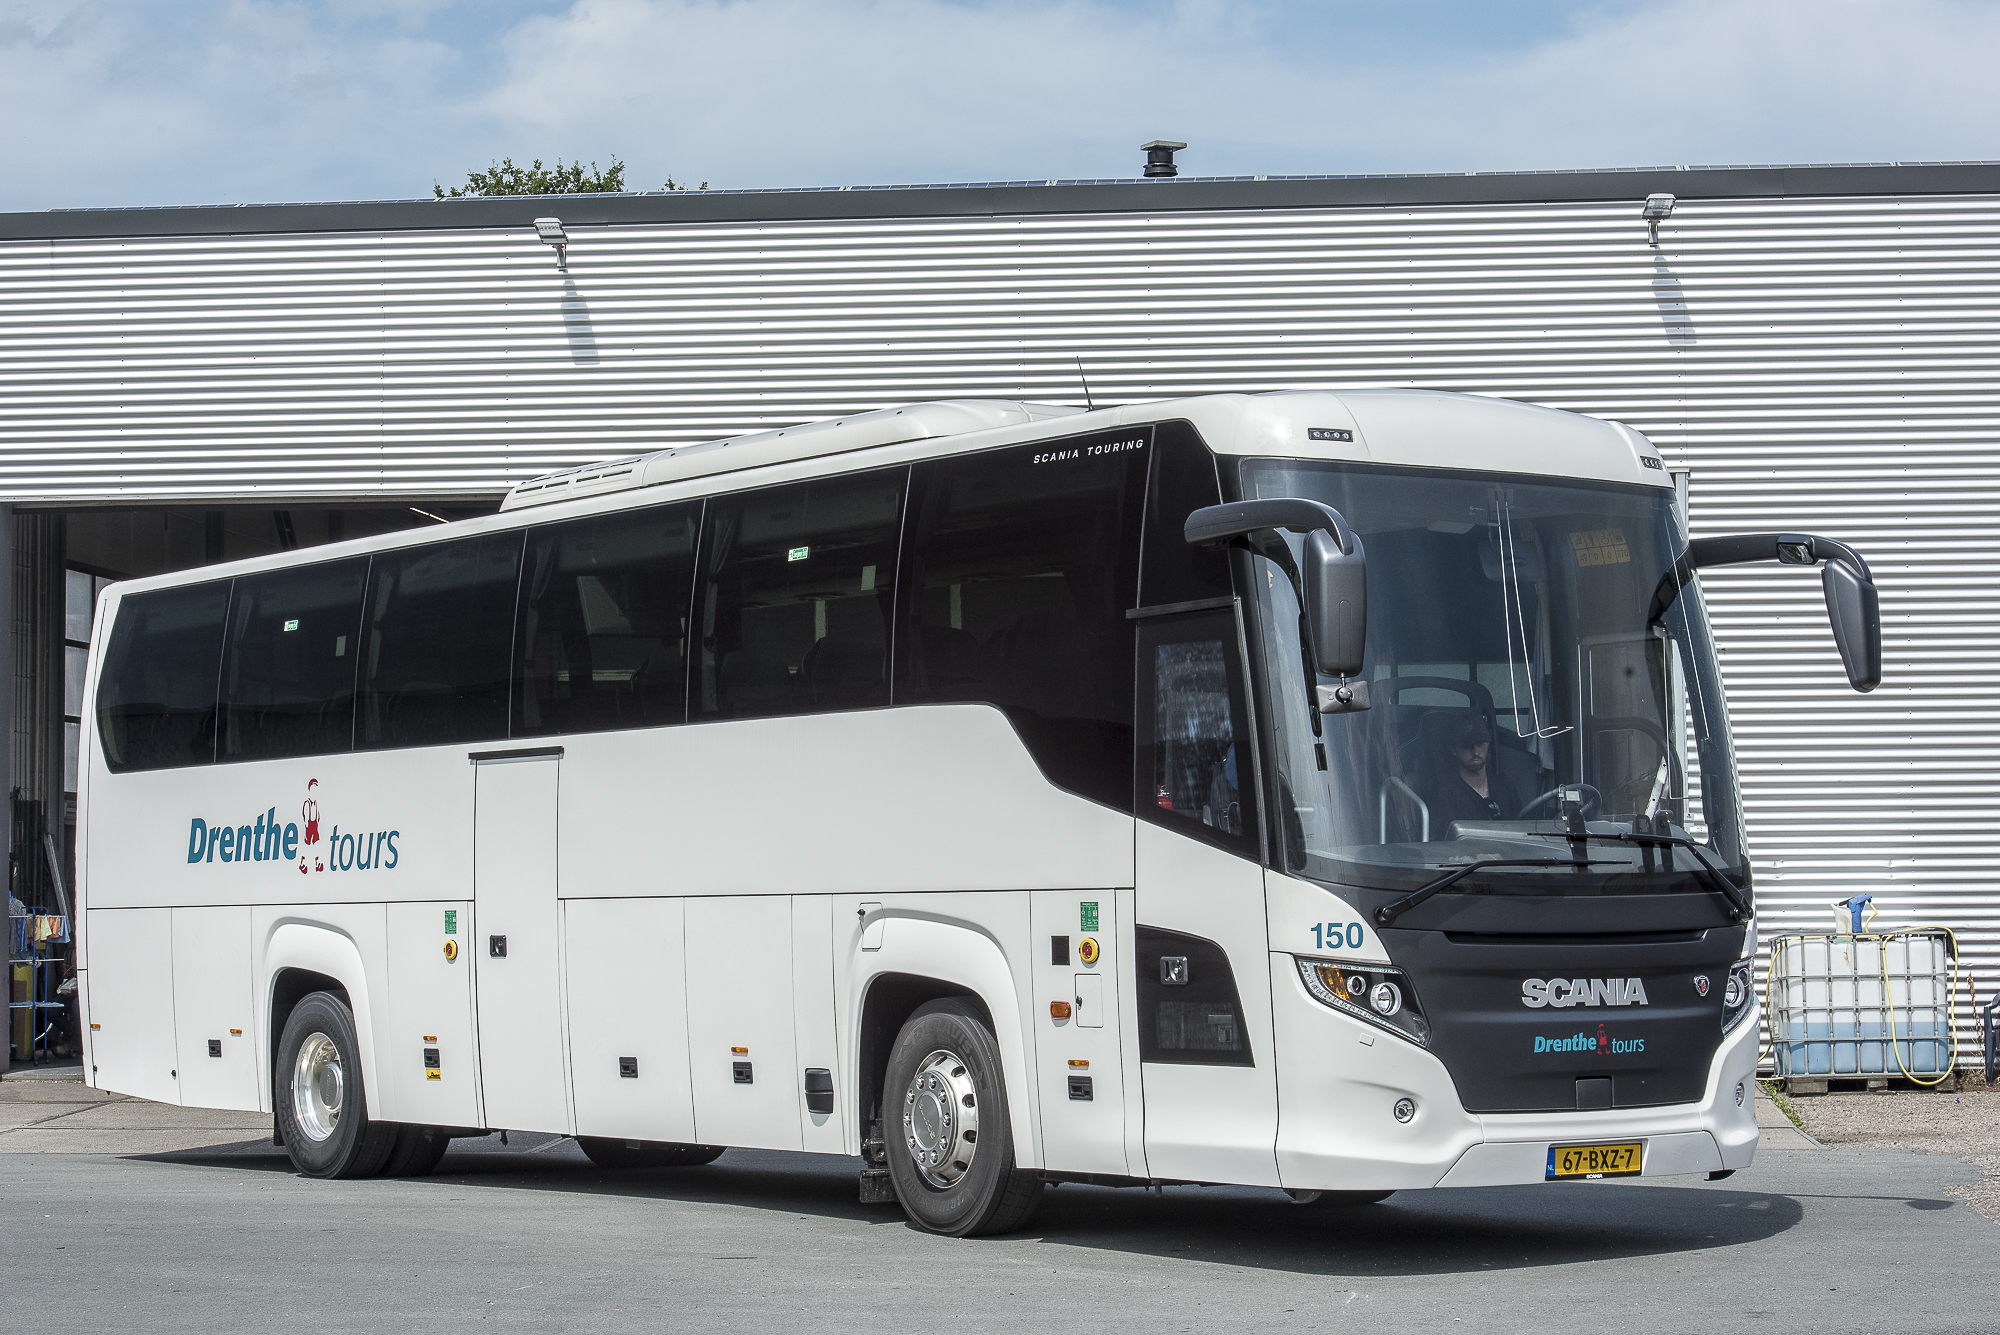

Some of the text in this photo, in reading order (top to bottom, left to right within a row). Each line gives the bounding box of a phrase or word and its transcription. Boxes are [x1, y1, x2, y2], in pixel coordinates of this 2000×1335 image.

[1033, 439, 1144, 464] SCANIA TOURING
[187, 806, 400, 872] Drenthe tours
[1310, 922, 1364, 949] 150
[1521, 977, 1649, 1008] SCANIA
[1533, 1032, 1645, 1053] Drenthe tours
[1562, 1148, 1634, 1171] 67-BXZ-7
